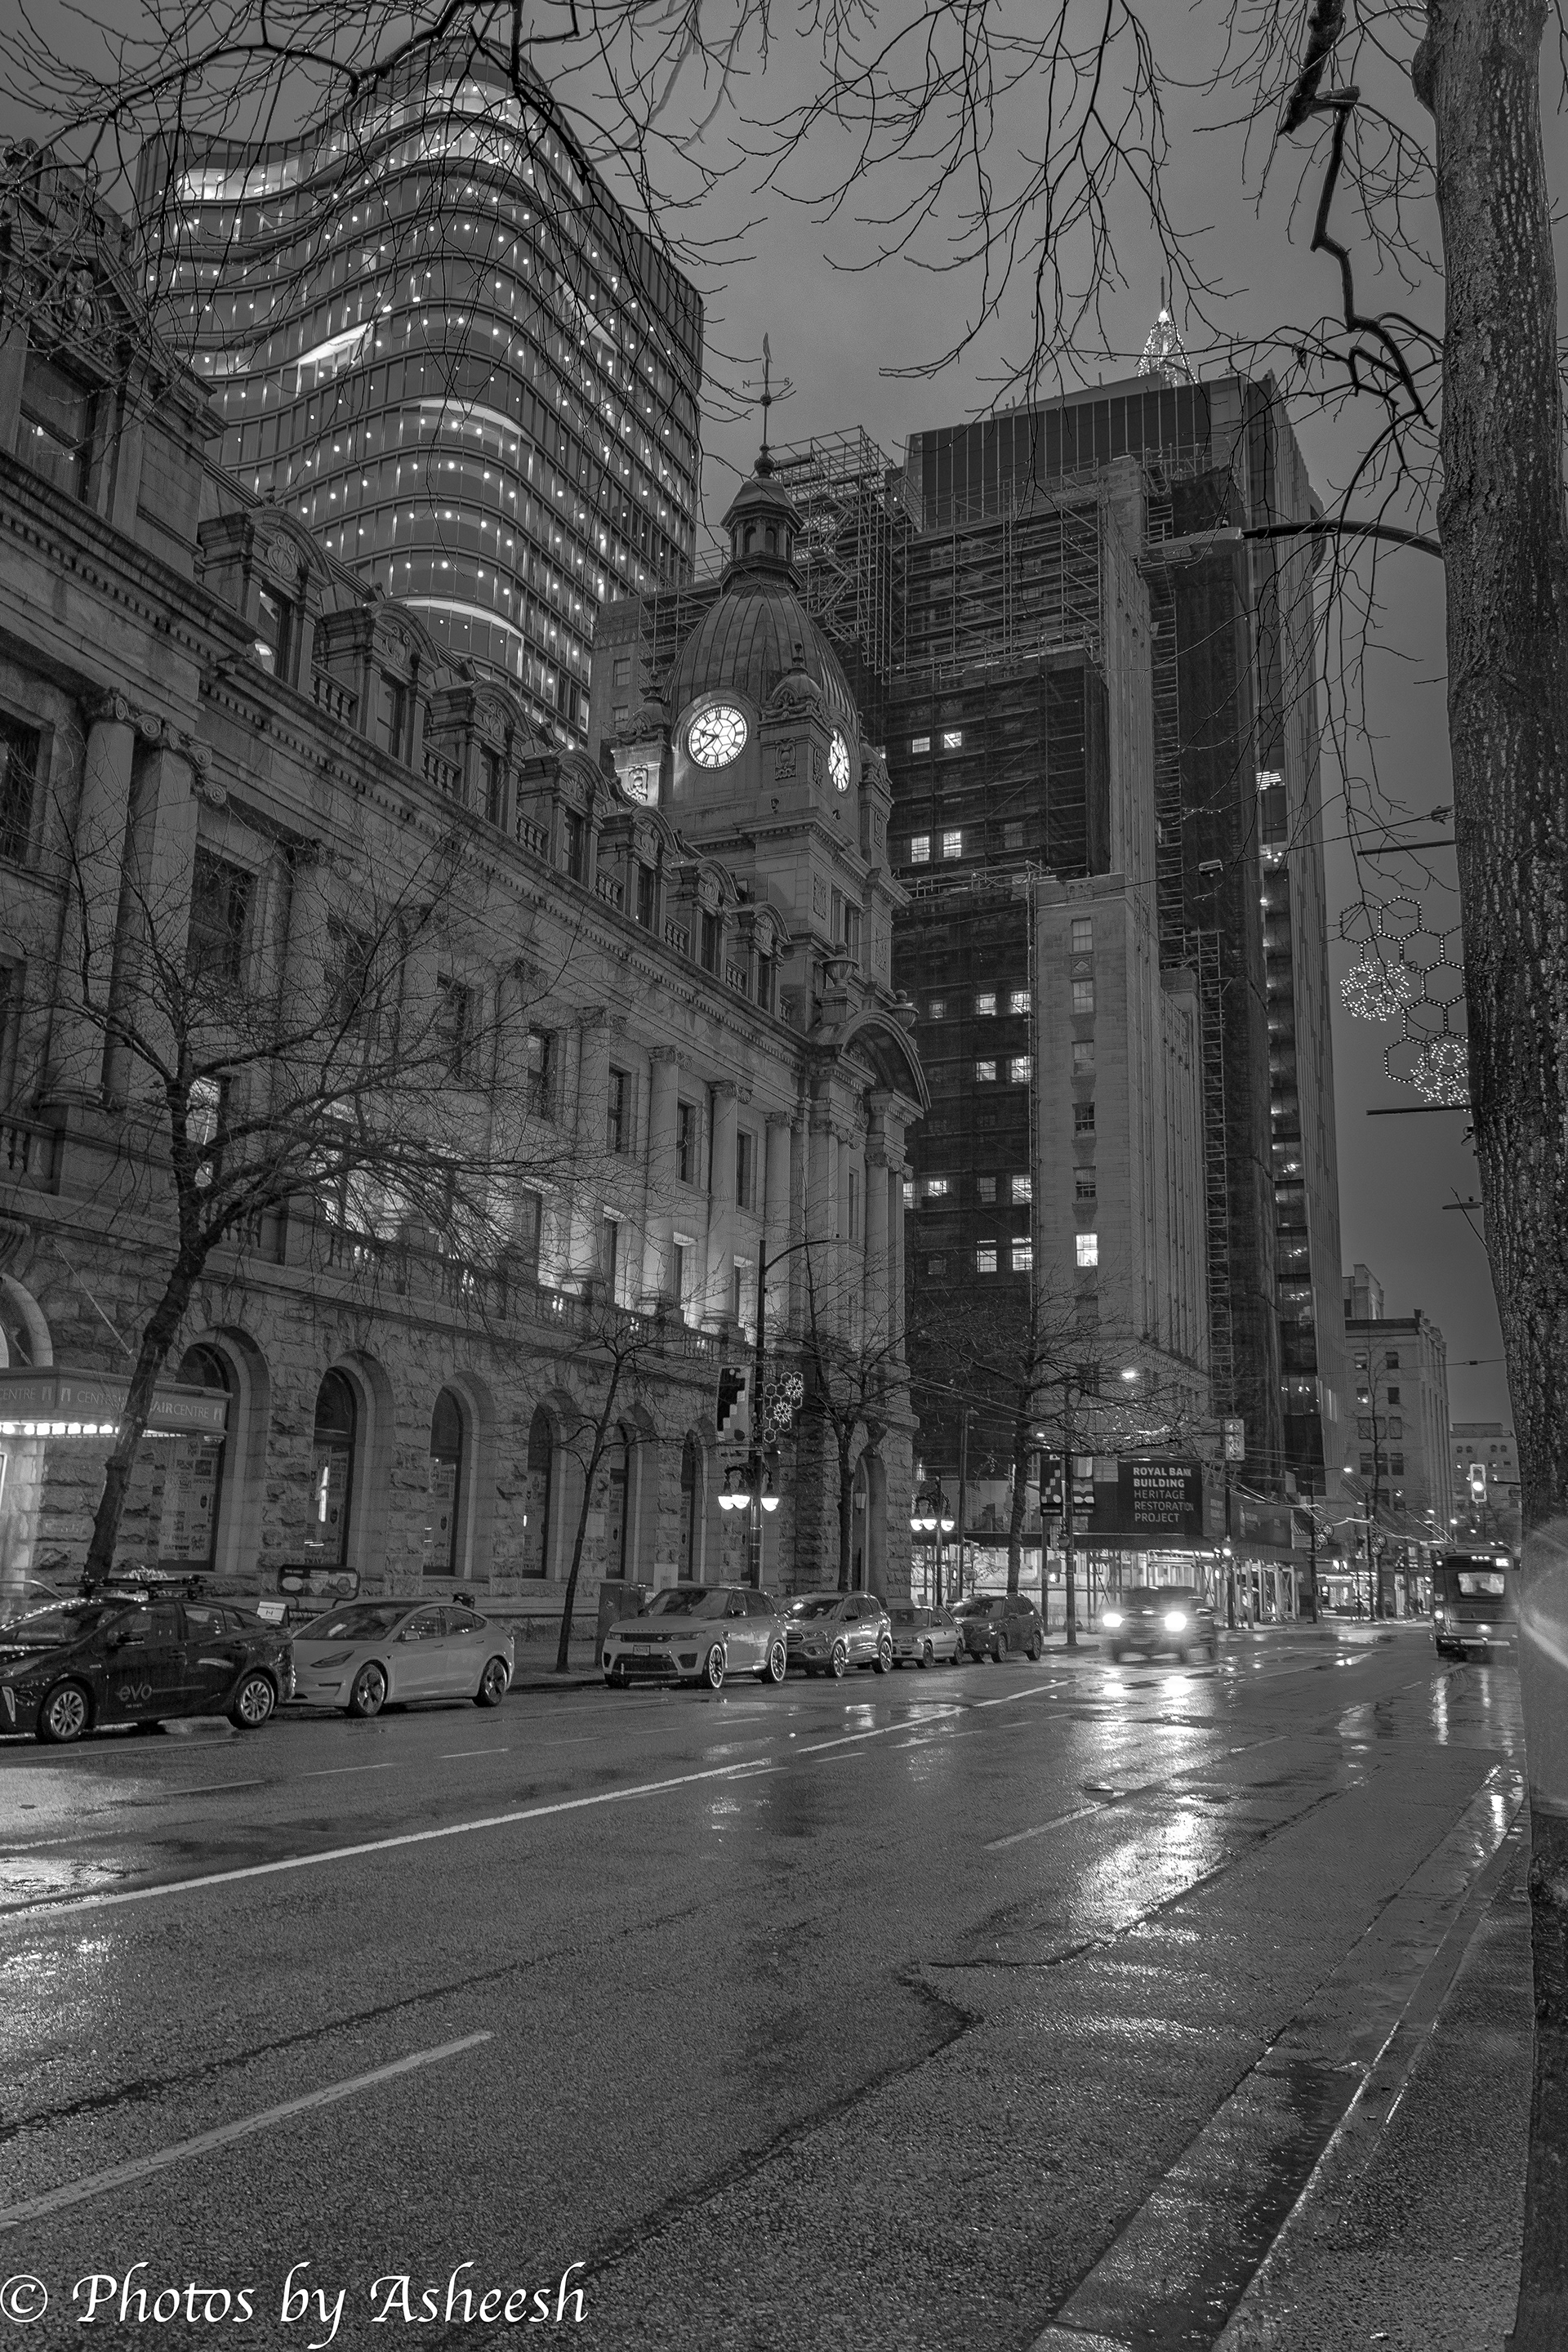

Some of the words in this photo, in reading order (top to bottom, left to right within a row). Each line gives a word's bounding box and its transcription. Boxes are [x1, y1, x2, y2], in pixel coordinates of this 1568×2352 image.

[742, 380, 750, 389] N
[784, 377, 790, 385] S
[1133, 1467, 1168, 1476] ROYAL
[1169, 1468, 1192, 1477] BANK
[1133, 1478, 1185, 1488] BUILDING
[1134, 1490, 1185, 1499] HERITAGE
[1134, 1501, 1194, 1511] RESTORATION
[1134, 1512, 1180, 1522] PROJECT
[119, 1682, 153, 1702] evo
